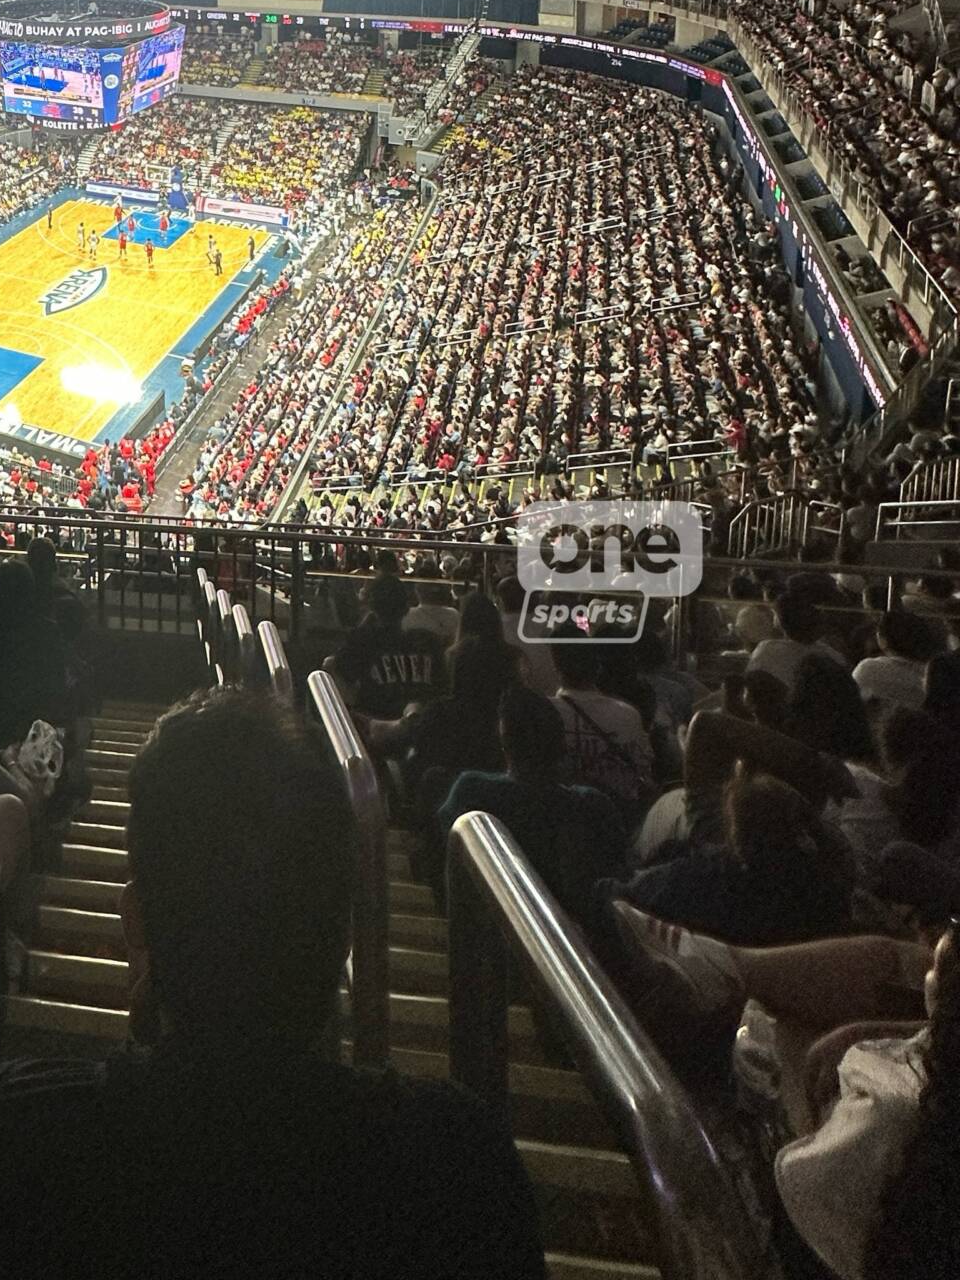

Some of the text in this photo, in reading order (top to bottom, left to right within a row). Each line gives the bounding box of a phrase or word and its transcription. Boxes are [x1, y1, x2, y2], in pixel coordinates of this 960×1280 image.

[26, 27, 63, 36] BUHAY
[66, 27, 81, 36] AT
[84, 24, 133, 36] PAG-IBIG
[42, 120, 78, 130] KOLETTE
[205, 217, 268, 232] ARENA
[38, 269, 95, 305] ARENA
